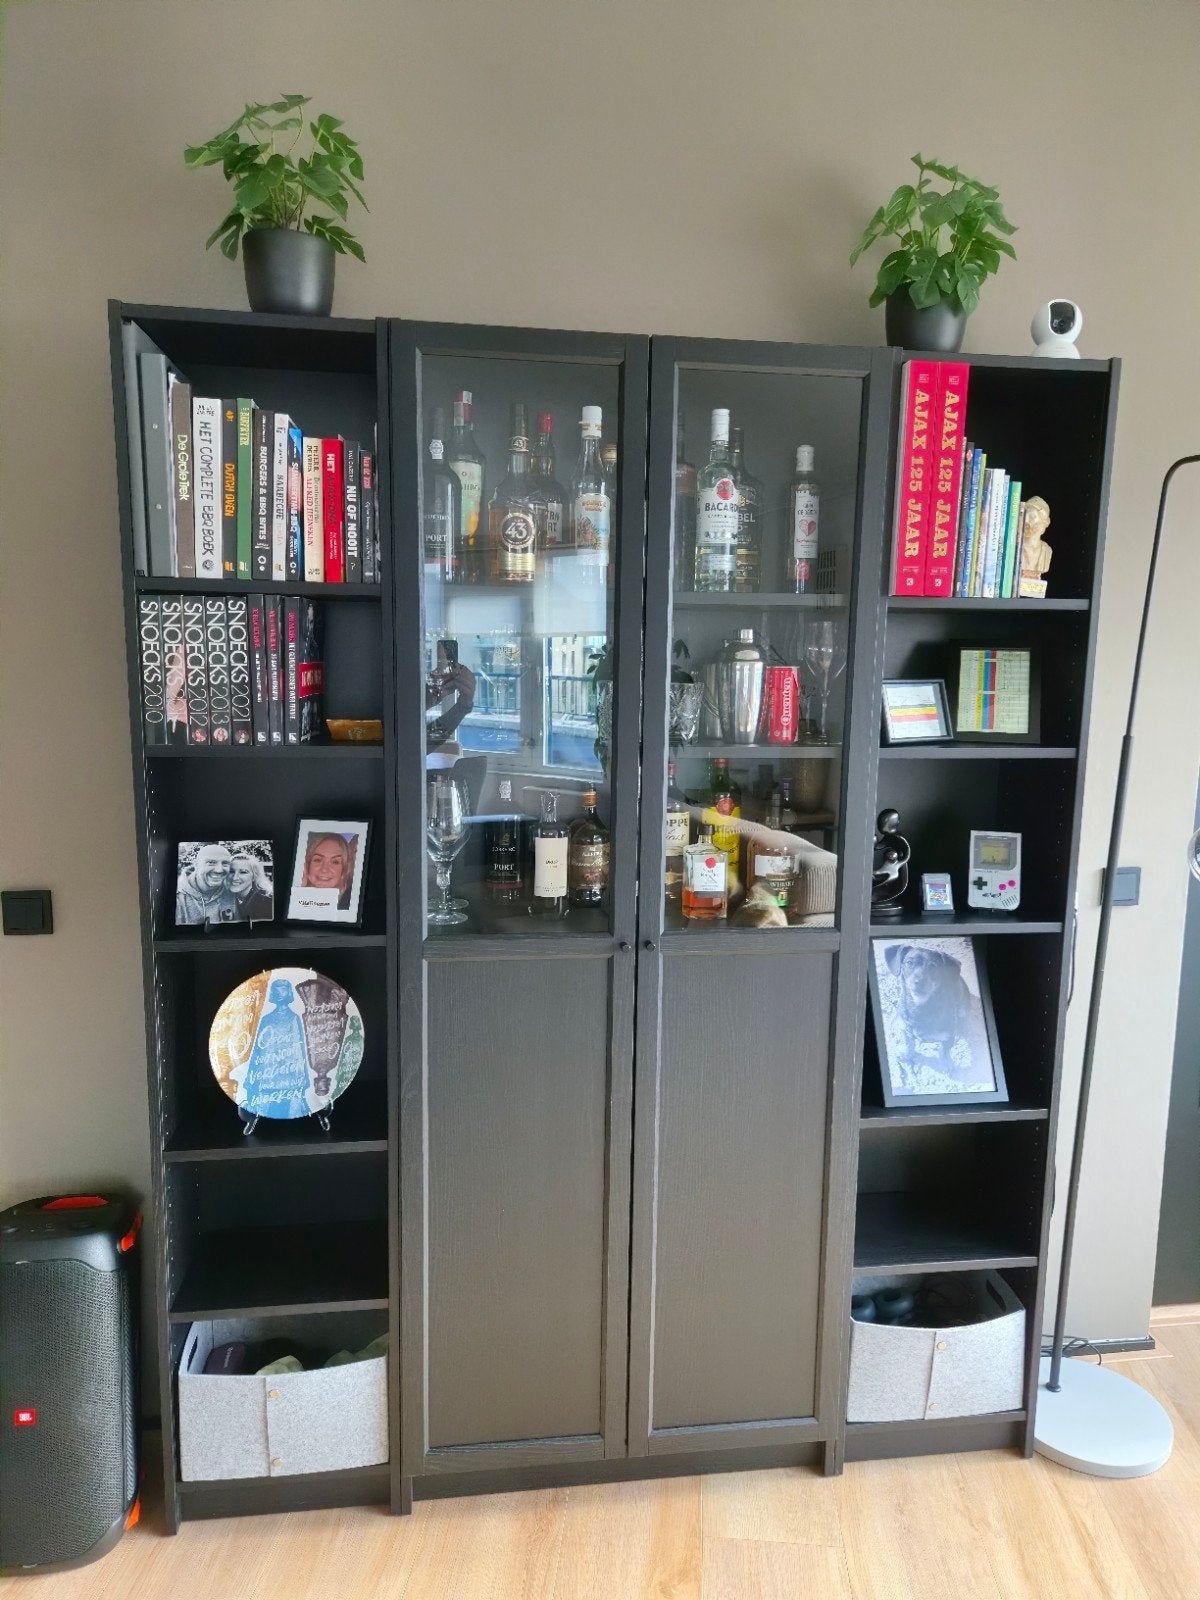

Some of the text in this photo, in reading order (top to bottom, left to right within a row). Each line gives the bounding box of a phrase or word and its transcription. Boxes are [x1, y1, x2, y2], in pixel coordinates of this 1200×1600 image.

[199, 421, 212, 445] HET
[912, 389, 930, 450] AJAX
[941, 390, 960, 451] AJAX
[177, 435, 188, 450] De
[513, 440, 524, 448] 43
[200, 446, 214, 500] COMPLETE
[259, 446, 268, 487] BURGERS
[326, 453, 335, 473] HET
[909, 456, 924, 492] 125
[938, 457, 954, 493] 125
[179, 481, 190, 501] Trek
[224, 463, 235, 517] DUTCH OVEN
[259, 496, 267, 516] BBQ
[275, 474, 284, 520] BARBECUE
[704, 502, 739, 512] BACARD
[202, 505, 213, 527] BBQ
[259, 517, 267, 540] BITES
[347, 485, 358, 558] NU OF NOOIT
[504, 522, 529, 539] 43
[738, 512, 756, 522] BEL
[904, 498, 922, 558] JAAR
[932, 500, 951, 558] JAAR
[202, 528, 214, 556] BOEK
[425, 534, 447, 542] PORT
[162, 601, 183, 686] SNOECKS
[227, 600, 251, 722] SNOECKS 2021
[140, 600, 163, 724] SNOECKS 2010
[184, 601, 208, 726] SNOECKS 2012
[206, 600, 230, 725] SNOECKS 2013
[494, 863, 514, 871] PORT
